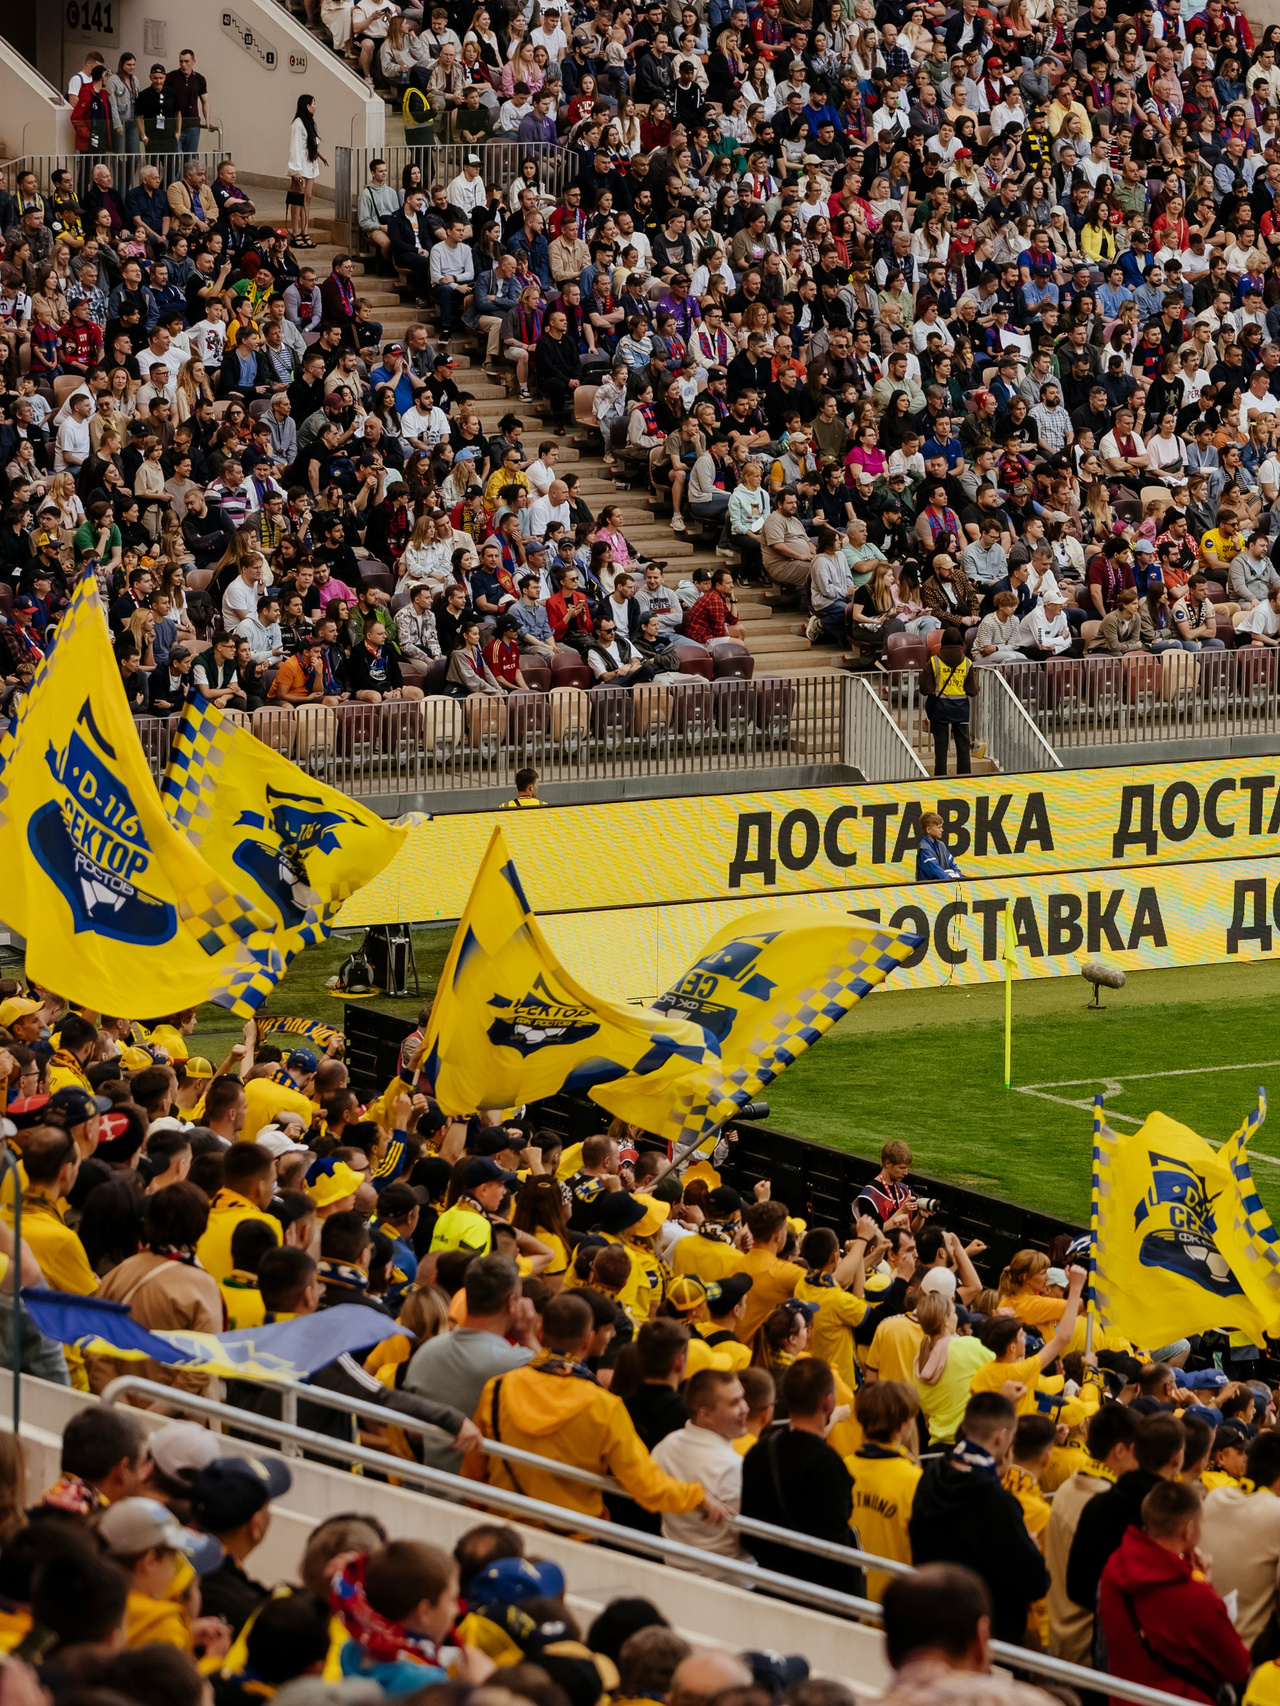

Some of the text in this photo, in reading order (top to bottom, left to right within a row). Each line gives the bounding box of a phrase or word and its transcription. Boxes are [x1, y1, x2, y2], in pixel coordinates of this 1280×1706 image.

[82, 1, 113, 33] 141
[296, 57, 305, 67] 141
[78, 770, 139, 837] D-116
[729, 792, 1054, 887] ДОСТАВКА
[74, 851, 135, 896] РОСТОВ
[514, 1006, 590, 1018] СЕКТОР
[516, 1017, 573, 1027] ФК РОСТОВ
[1179, 1232, 1201, 1244] ФК
